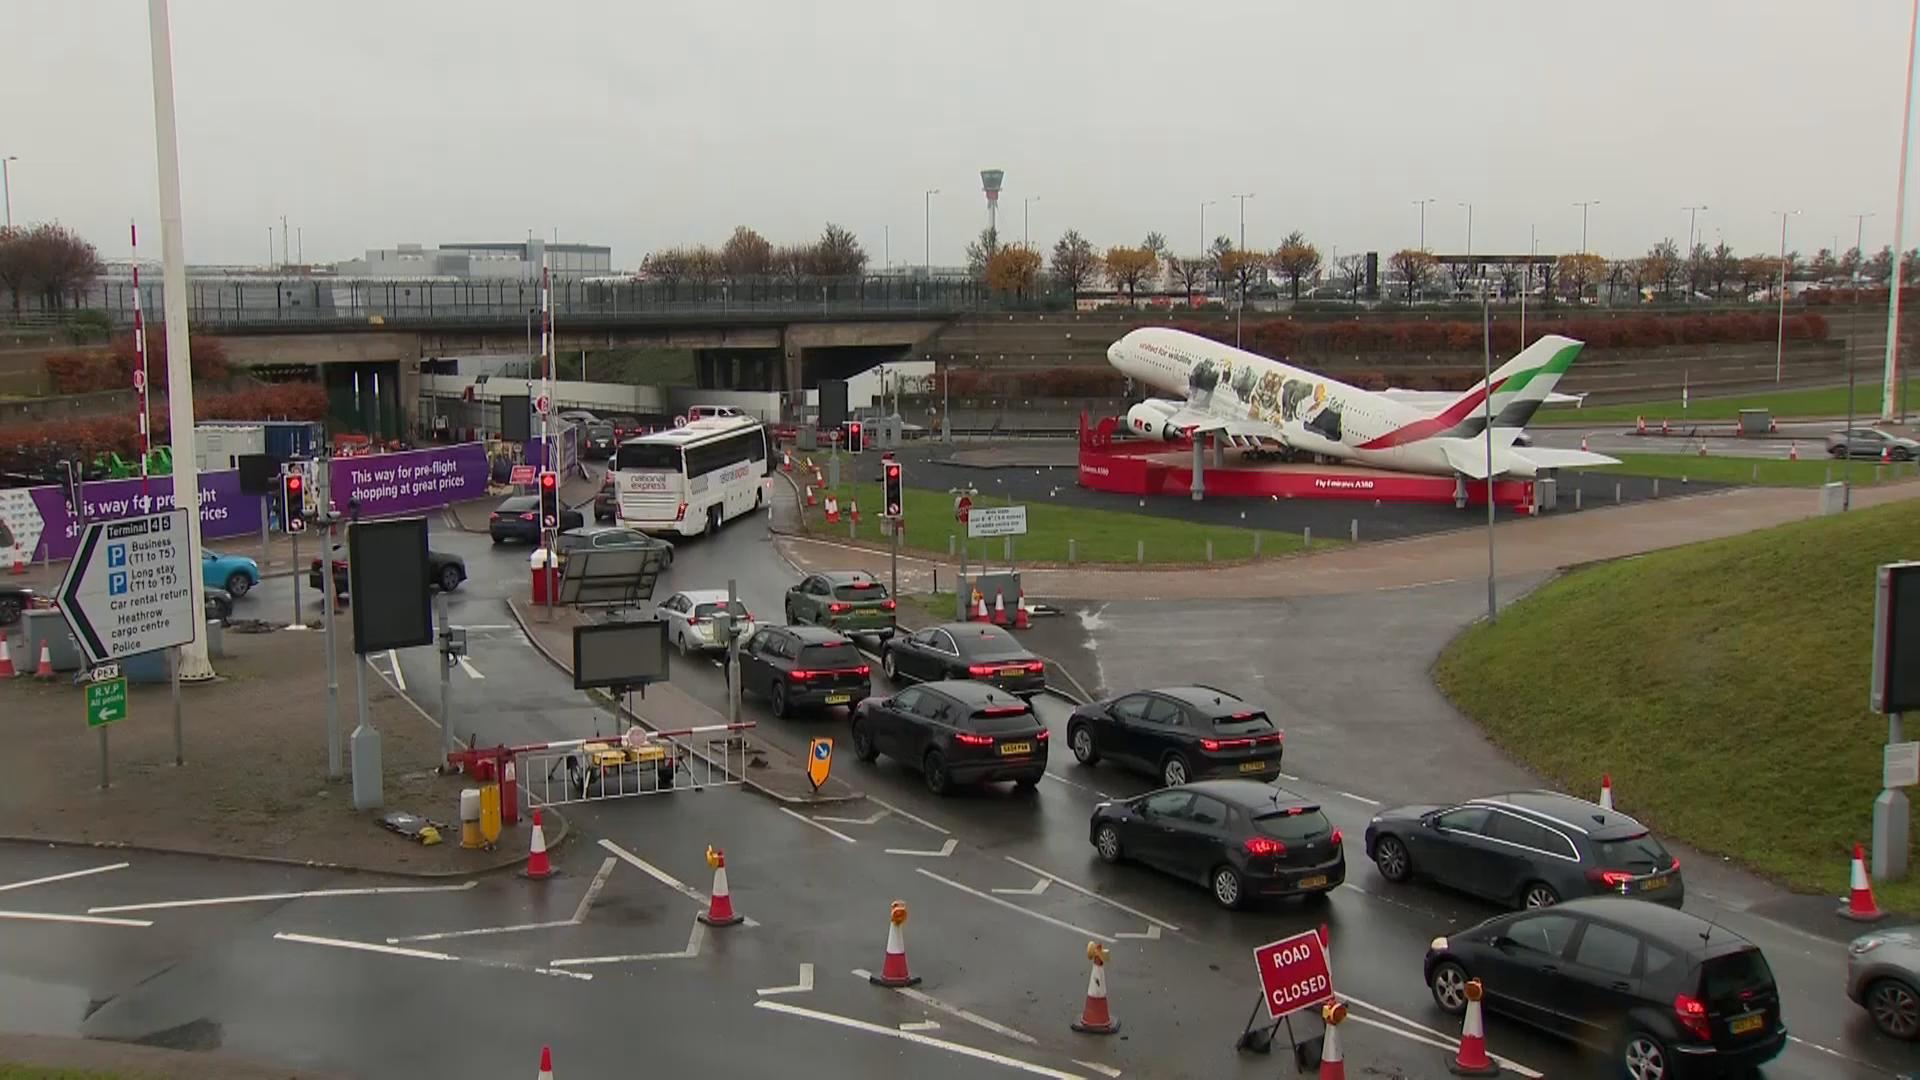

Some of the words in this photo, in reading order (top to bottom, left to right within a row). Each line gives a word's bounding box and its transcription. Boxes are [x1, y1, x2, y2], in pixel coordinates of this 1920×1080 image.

[351, 469, 371, 484] This
[375, 470, 395, 483] way
[398, 465, 412, 479] for
[415, 460, 457, 478] pre-flight
[630, 473, 666, 483] national
[352, 483, 398, 501] shopping
[400, 482, 410, 495] at
[413, 479, 437, 496] great
[439, 475, 465, 492] prices
[631, 482, 667, 491] express
[99, 499, 129, 515] way
[200, 506, 228, 521] rices
[108, 522, 148, 537] Terminal
[152, 518, 159, 531] 4
[163, 516, 171, 529] 5
[132, 538, 171, 551] Business
[129, 552, 144, 566] (T1
[147, 551, 156, 561] to
[159, 547, 176, 559] T5)
[131, 567, 153, 580] Long
[156, 564, 175, 576] stay
[130, 579, 145, 592] (T1
[148, 578, 157, 588] to
[161, 574, 177, 586] T5)
[110, 599, 127, 611] Car
[130, 594, 157, 607] rental
[160, 588, 188, 600] return
[118, 608, 163, 624] Heathrow
[111, 625, 137, 638] cargo
[141, 618, 170, 632] centre
[112, 640, 141, 654] Police
[1273, 943, 1311, 968] ROAD
[1273, 974, 1327, 1005] CLOSED
